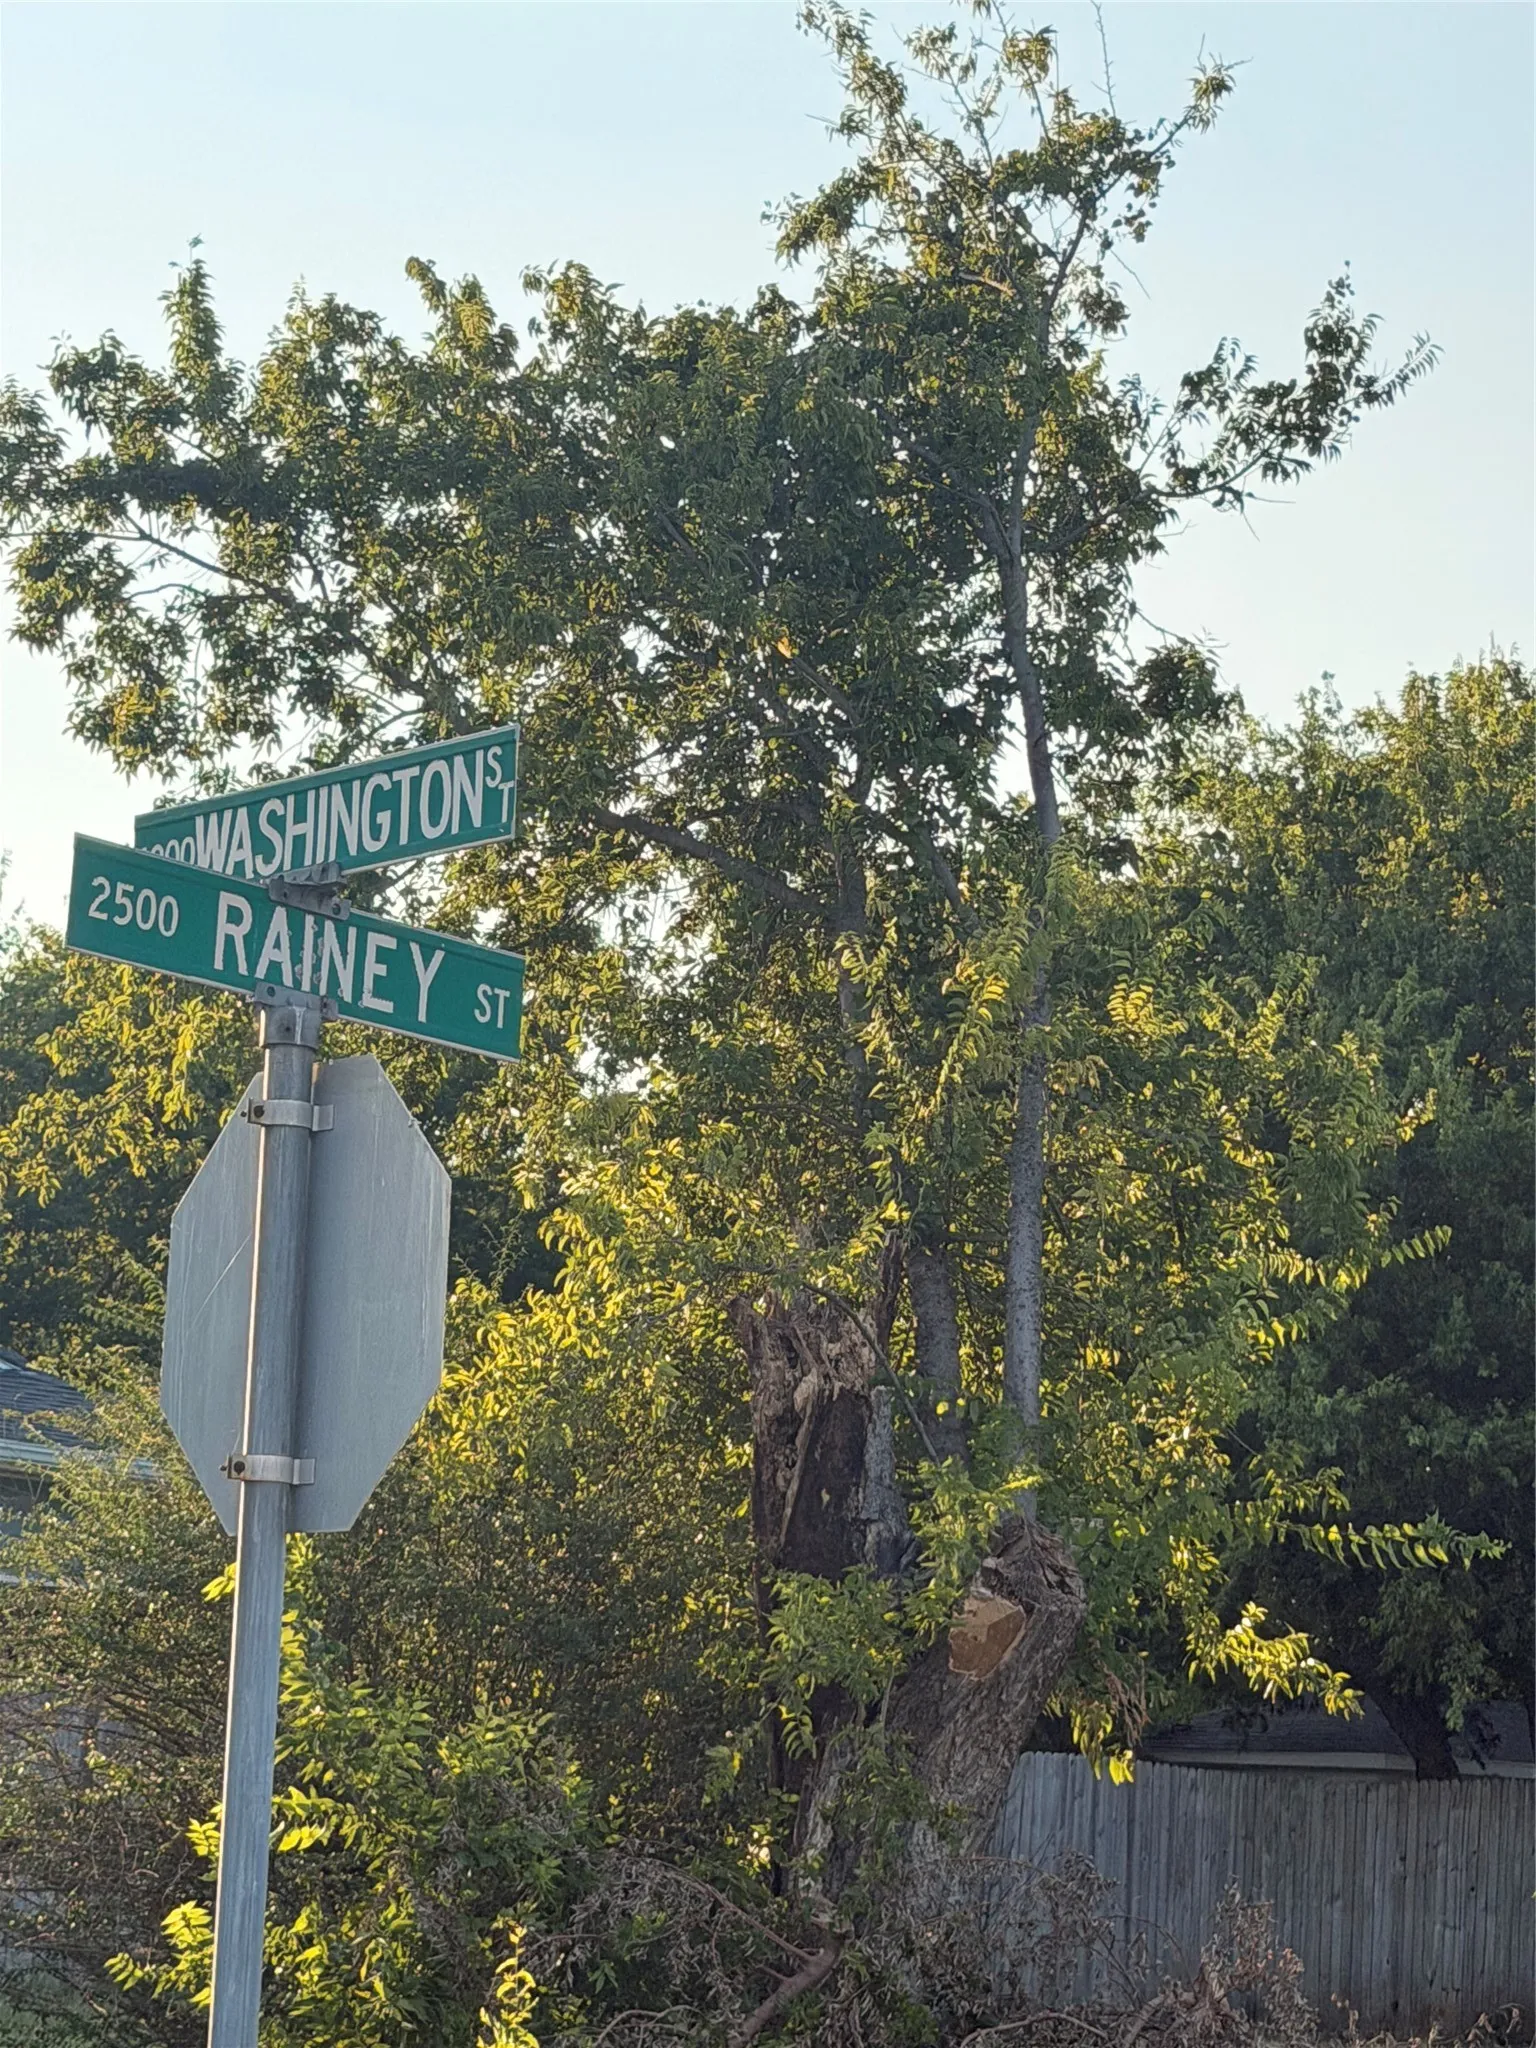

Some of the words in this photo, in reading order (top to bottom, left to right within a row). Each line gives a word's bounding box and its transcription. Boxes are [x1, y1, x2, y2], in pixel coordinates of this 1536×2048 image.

[195, 749, 484, 879] WASHINGTON
[485, 745, 515, 823] ST
[88, 876, 180, 938] 2500
[213, 891, 445, 1023] RAINEY
[474, 983, 511, 1029] ST
